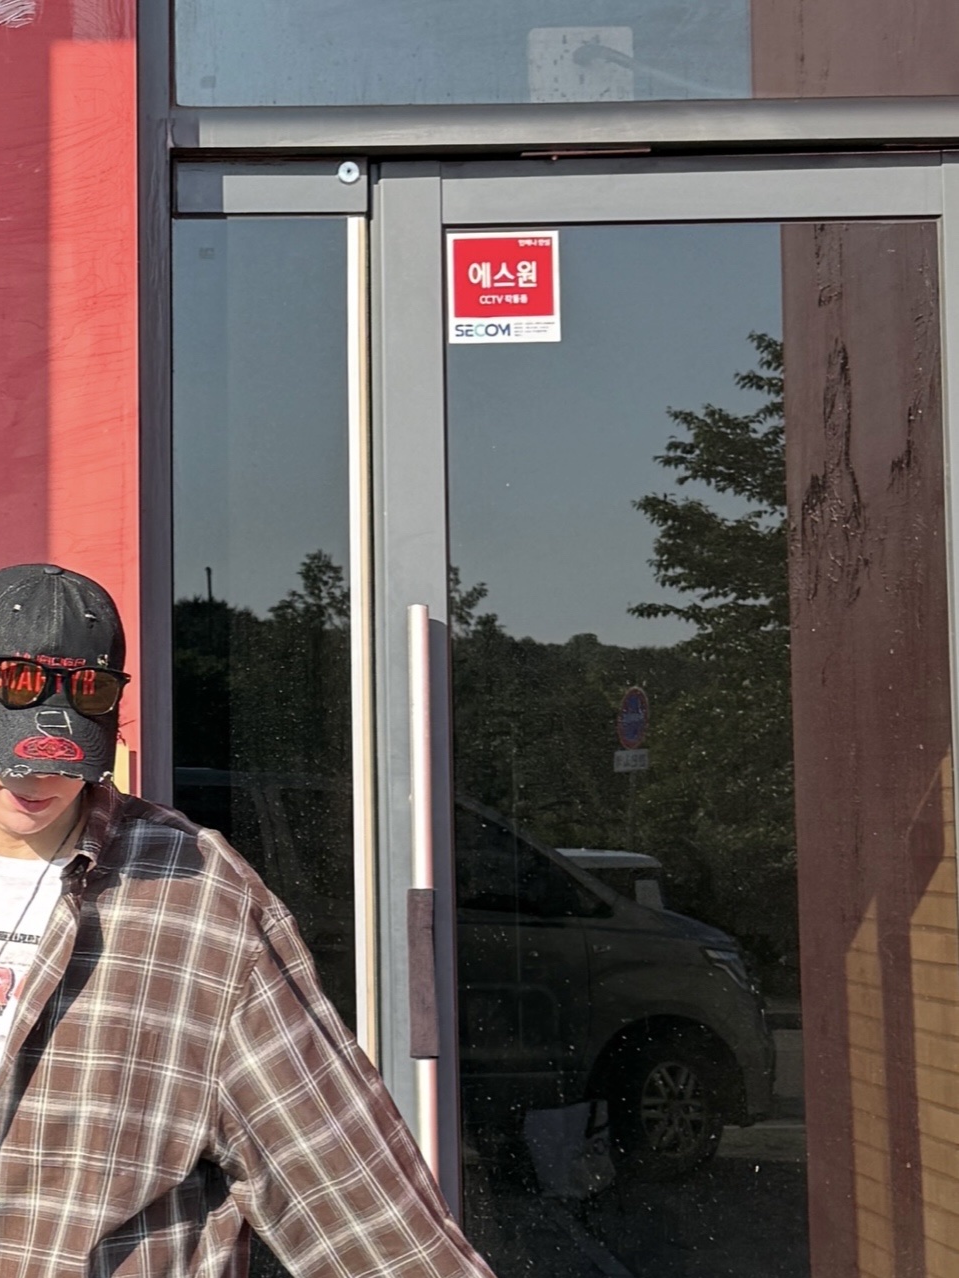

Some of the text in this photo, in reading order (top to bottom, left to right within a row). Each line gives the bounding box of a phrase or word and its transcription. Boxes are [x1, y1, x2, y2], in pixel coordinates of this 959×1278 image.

[468, 260, 537, 288] 에스원
[479, 294, 504, 304] CCTV
[455, 323, 511, 337] SECOM
